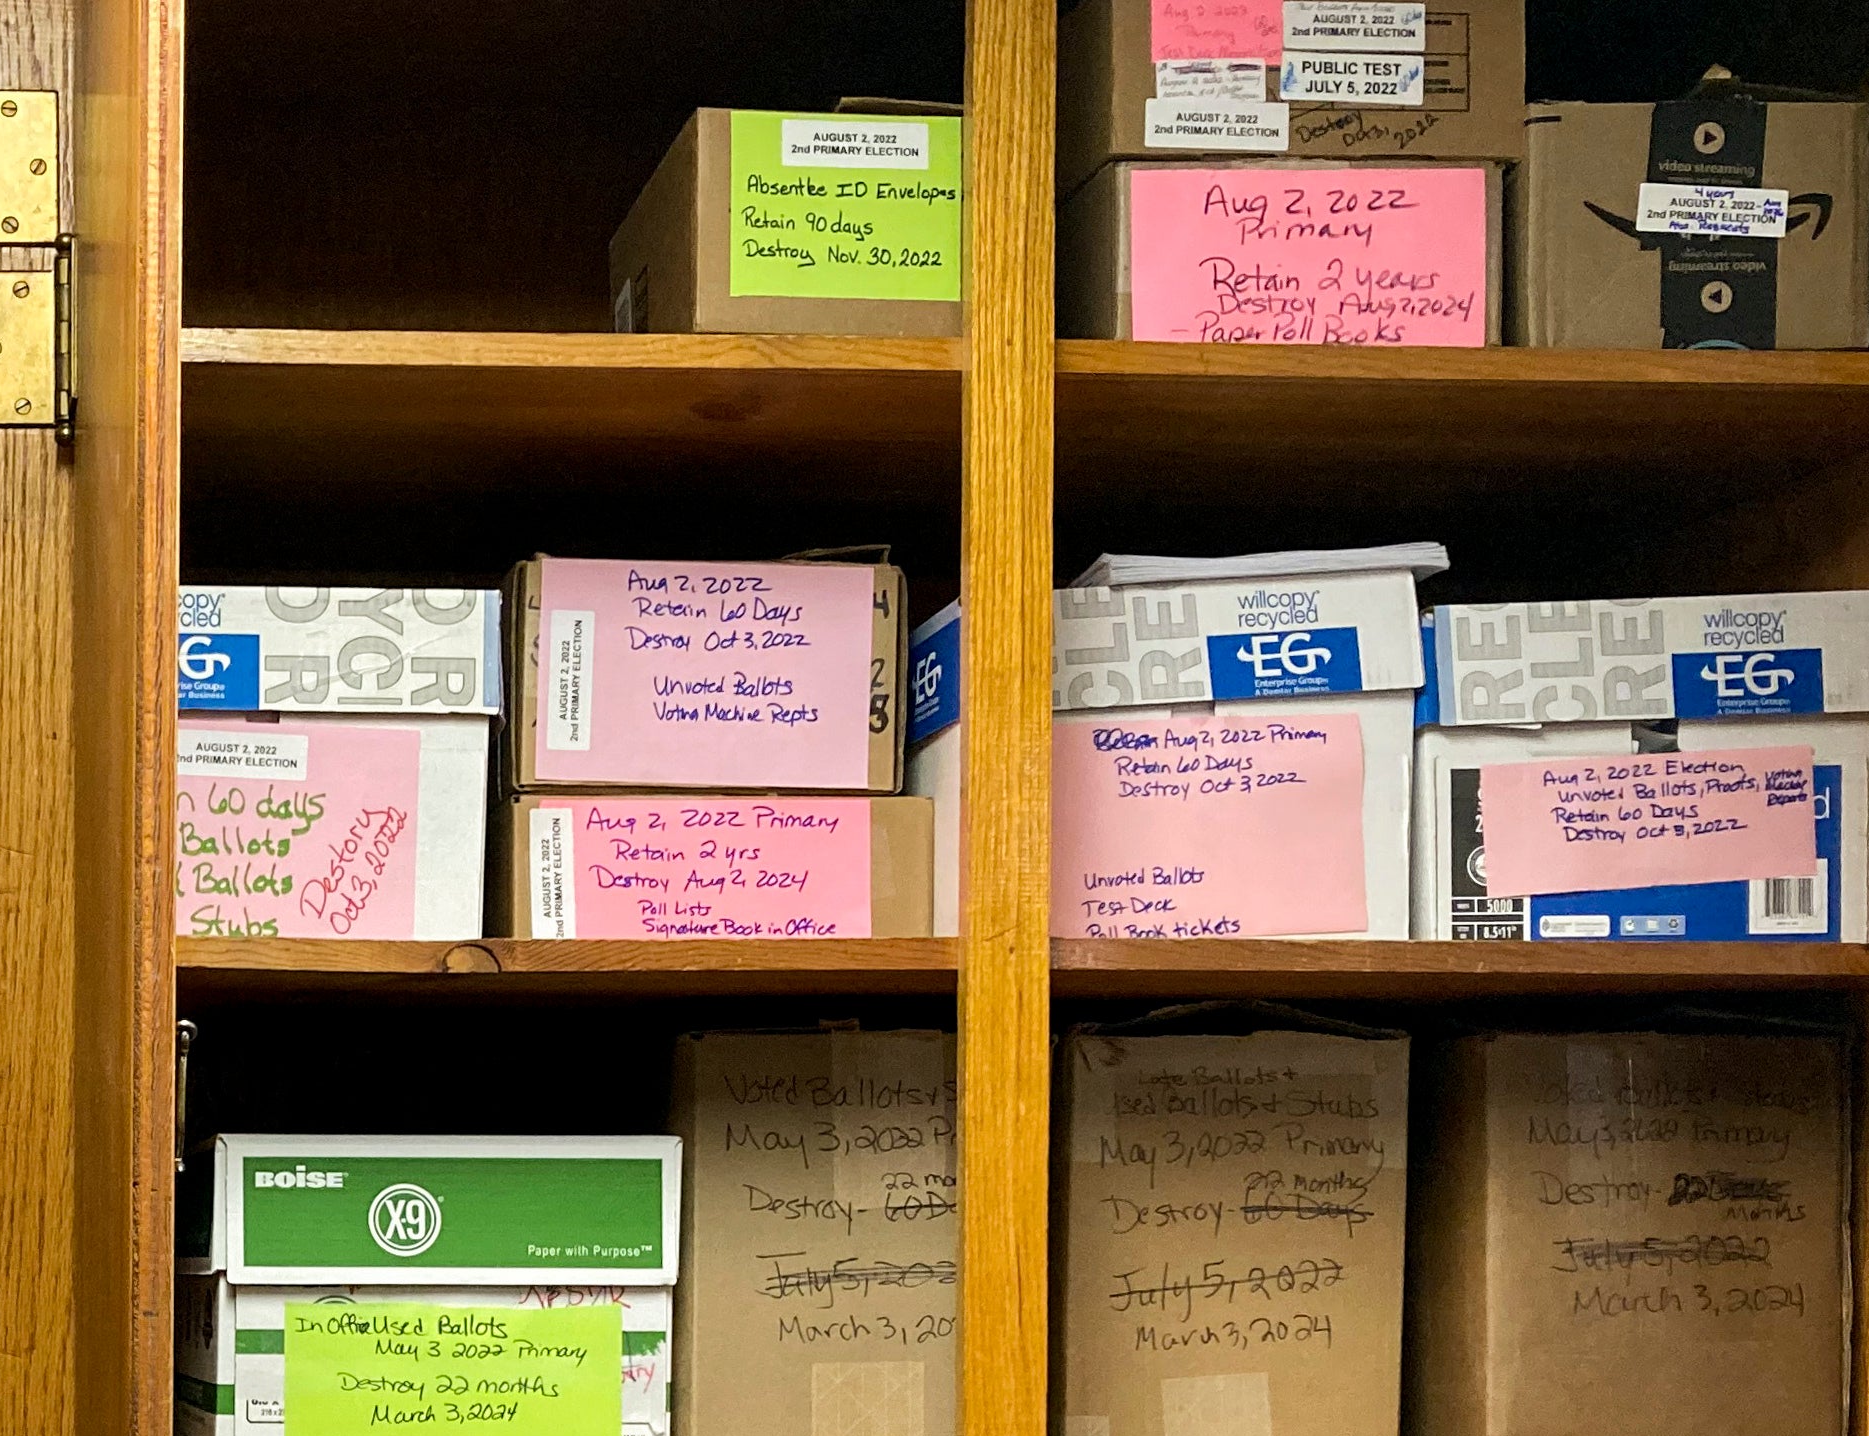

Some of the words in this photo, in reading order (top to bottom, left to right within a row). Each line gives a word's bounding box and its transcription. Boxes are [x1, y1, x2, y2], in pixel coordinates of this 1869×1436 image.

[1313, 14, 1357, 23] AUGUST
[1372, 16, 1395, 24] 2022
[1292, 27, 1310, 36] 2nd
[1313, 27, 1360, 36] PRIMARY
[1363, 28, 1416, 38] ELECTION
[1302, 61, 1358, 74] PUBLIC
[1363, 63, 1402, 76] TEST
[1305, 80, 1343, 93] JULY
[1347, 81, 1360, 95] 5,
[1364, 82, 1398, 94] 2022
[813, 132, 858, 142] AUGUST
[861, 134, 870, 143] 2,
[873, 134, 897, 144] 2022
[792, 144, 810, 154] 2nd
[813, 145, 862, 154] PRIMARY
[866, 147, 919, 157] ELECTION
[835, 180, 868, 198] ID
[1204, 185, 1268, 218] Aug
[1328, 188, 1420, 213] 2022
[741, 206, 795, 230] Retain
[806, 214, 827, 232] 90
[830, 212, 874, 241] days
[1239, 216, 1372, 247] Primary
[743, 239, 816, 268] Destroy
[1199, 257, 1300, 292] Retain
[1318, 259, 1343, 290] 2
[706, 577, 773, 595] 2022
[753, 598, 804, 622] Days
[1238, 589, 1320, 612] willcopy
[1238, 607, 1319, 630] recycled
[1487, 899, 1513, 914] 5000
[527, 1243, 561, 1260] Paper
[565, 1243, 588, 1257] with
[437, 1315, 509, 1340] Ballots
[375, 1339, 420, 1361] May
[428, 1341, 441, 1359] 3
[451, 1342, 505, 1360] 2022
[337, 1371, 425, 1397] Destroy
[436, 1375, 469, 1394] 22
[476, 1375, 559, 1398] months
